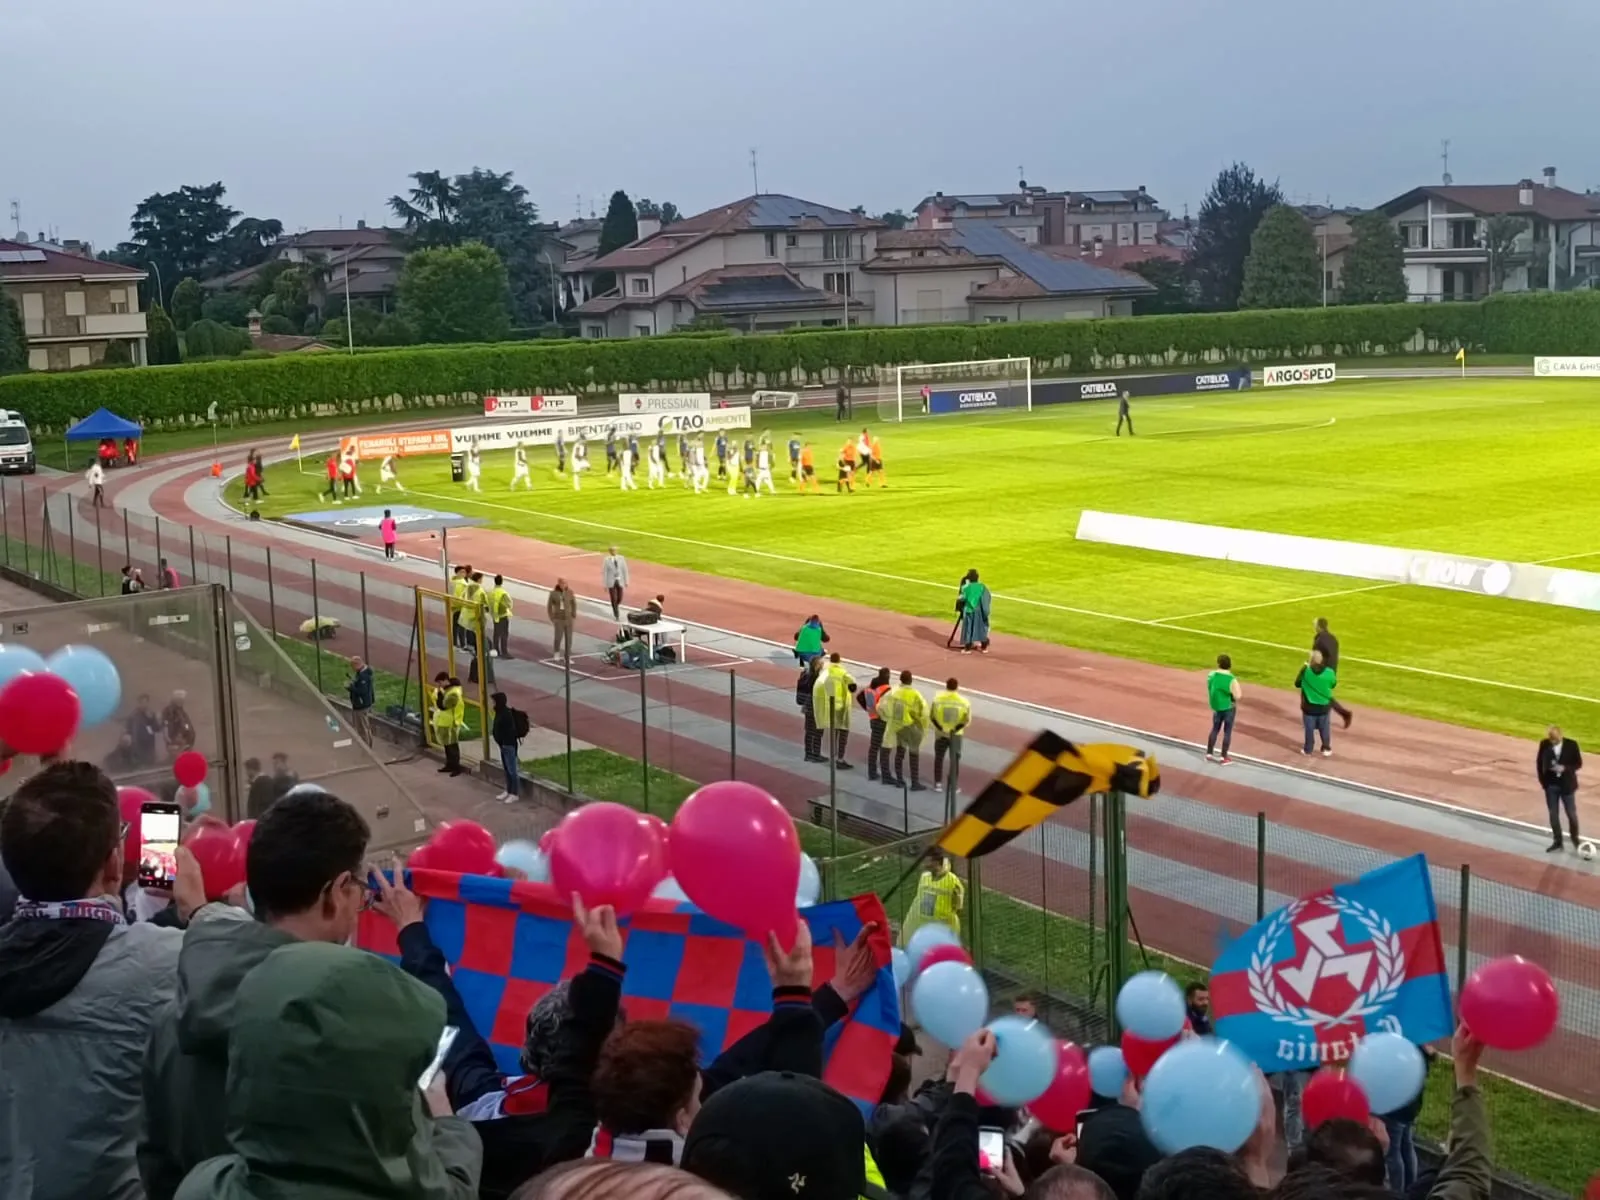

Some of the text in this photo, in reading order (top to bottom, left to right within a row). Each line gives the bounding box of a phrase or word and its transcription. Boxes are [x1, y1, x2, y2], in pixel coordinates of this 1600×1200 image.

[1553, 362, 1577, 371] CAVA
[1267, 367, 1334, 383] ARGOSPED
[647, 397, 700, 409] PRESSIANI
[673, 415, 703, 430] TAO
[455, 428, 552, 443] VUEMME VUEMME
